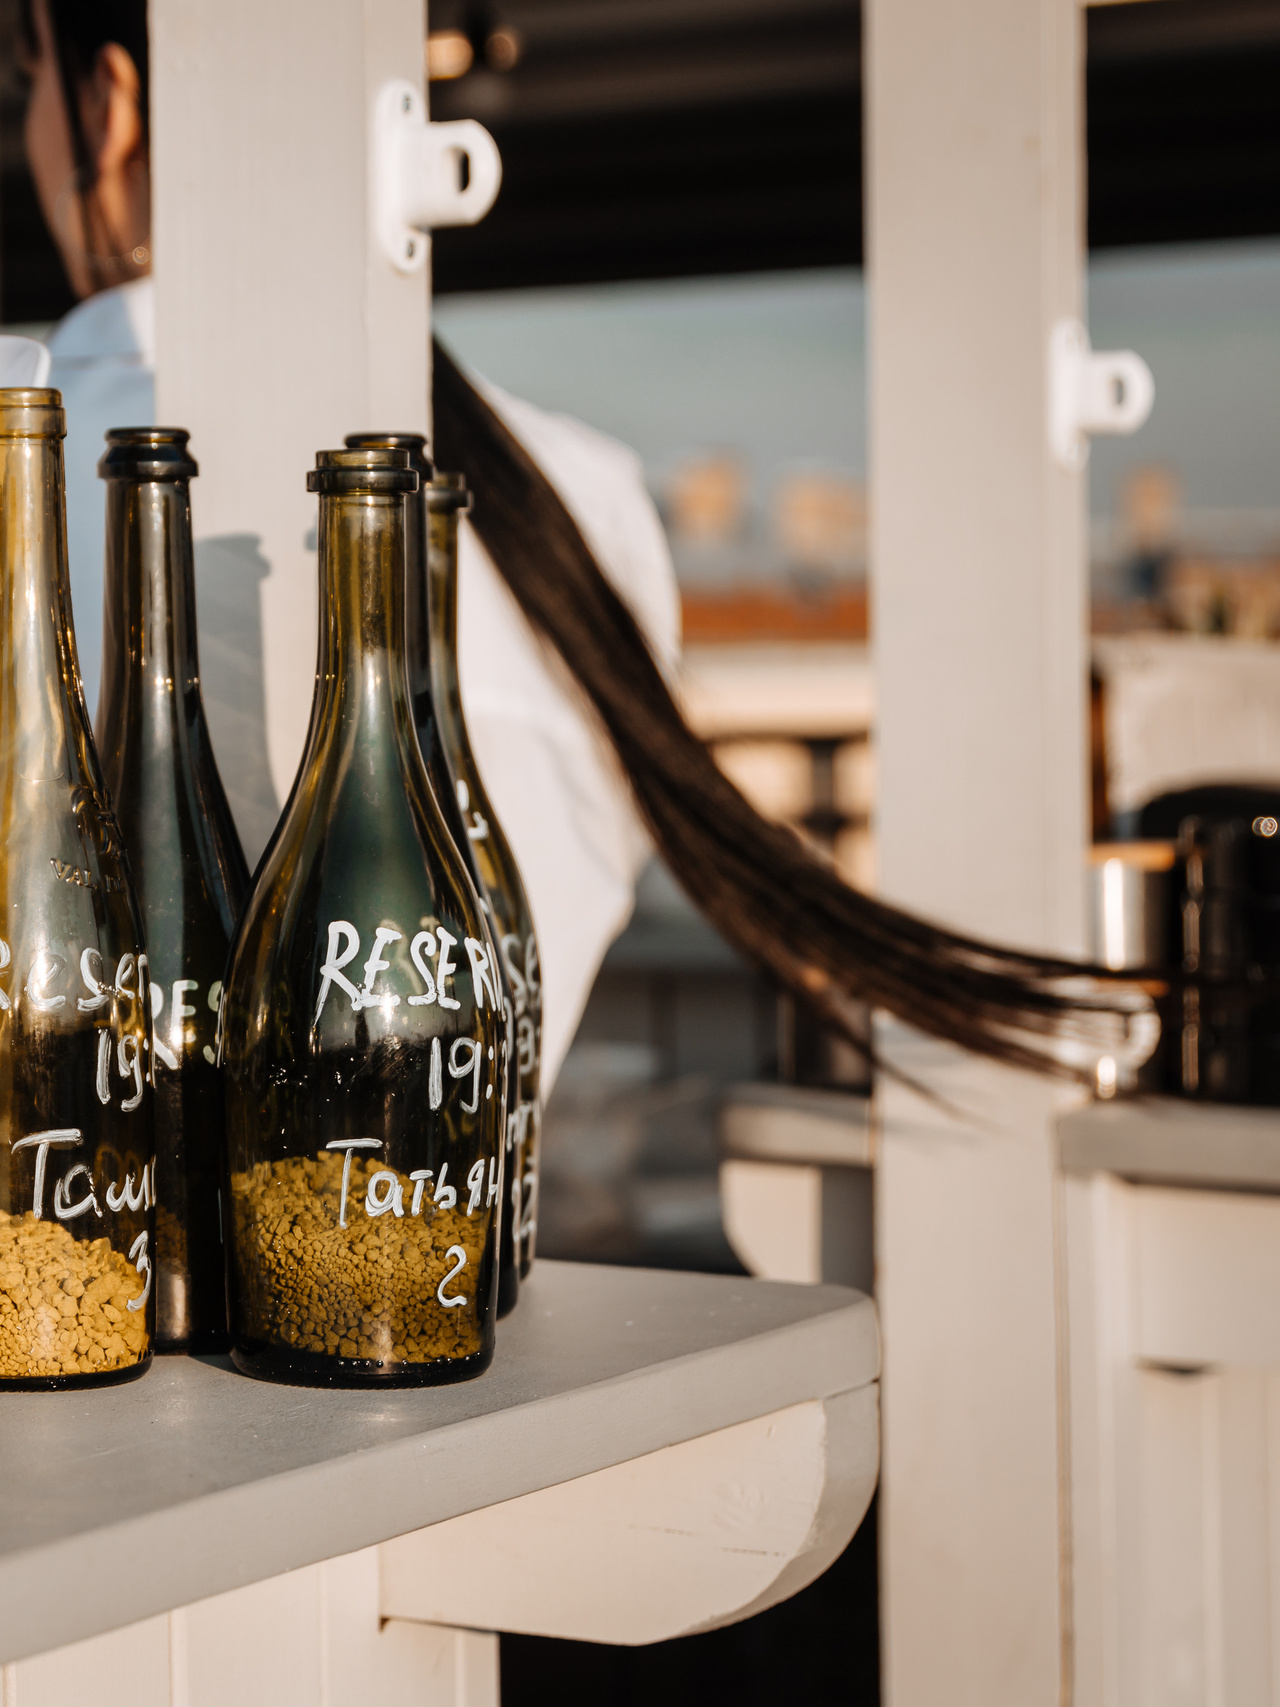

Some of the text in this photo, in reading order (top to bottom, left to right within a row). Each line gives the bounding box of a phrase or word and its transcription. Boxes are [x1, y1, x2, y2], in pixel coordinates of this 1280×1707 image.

[96, 1028, 157, 1111] 19:
[428, 1037, 507, 1114] 19:
[437, 1245, 468, 1307] 2
